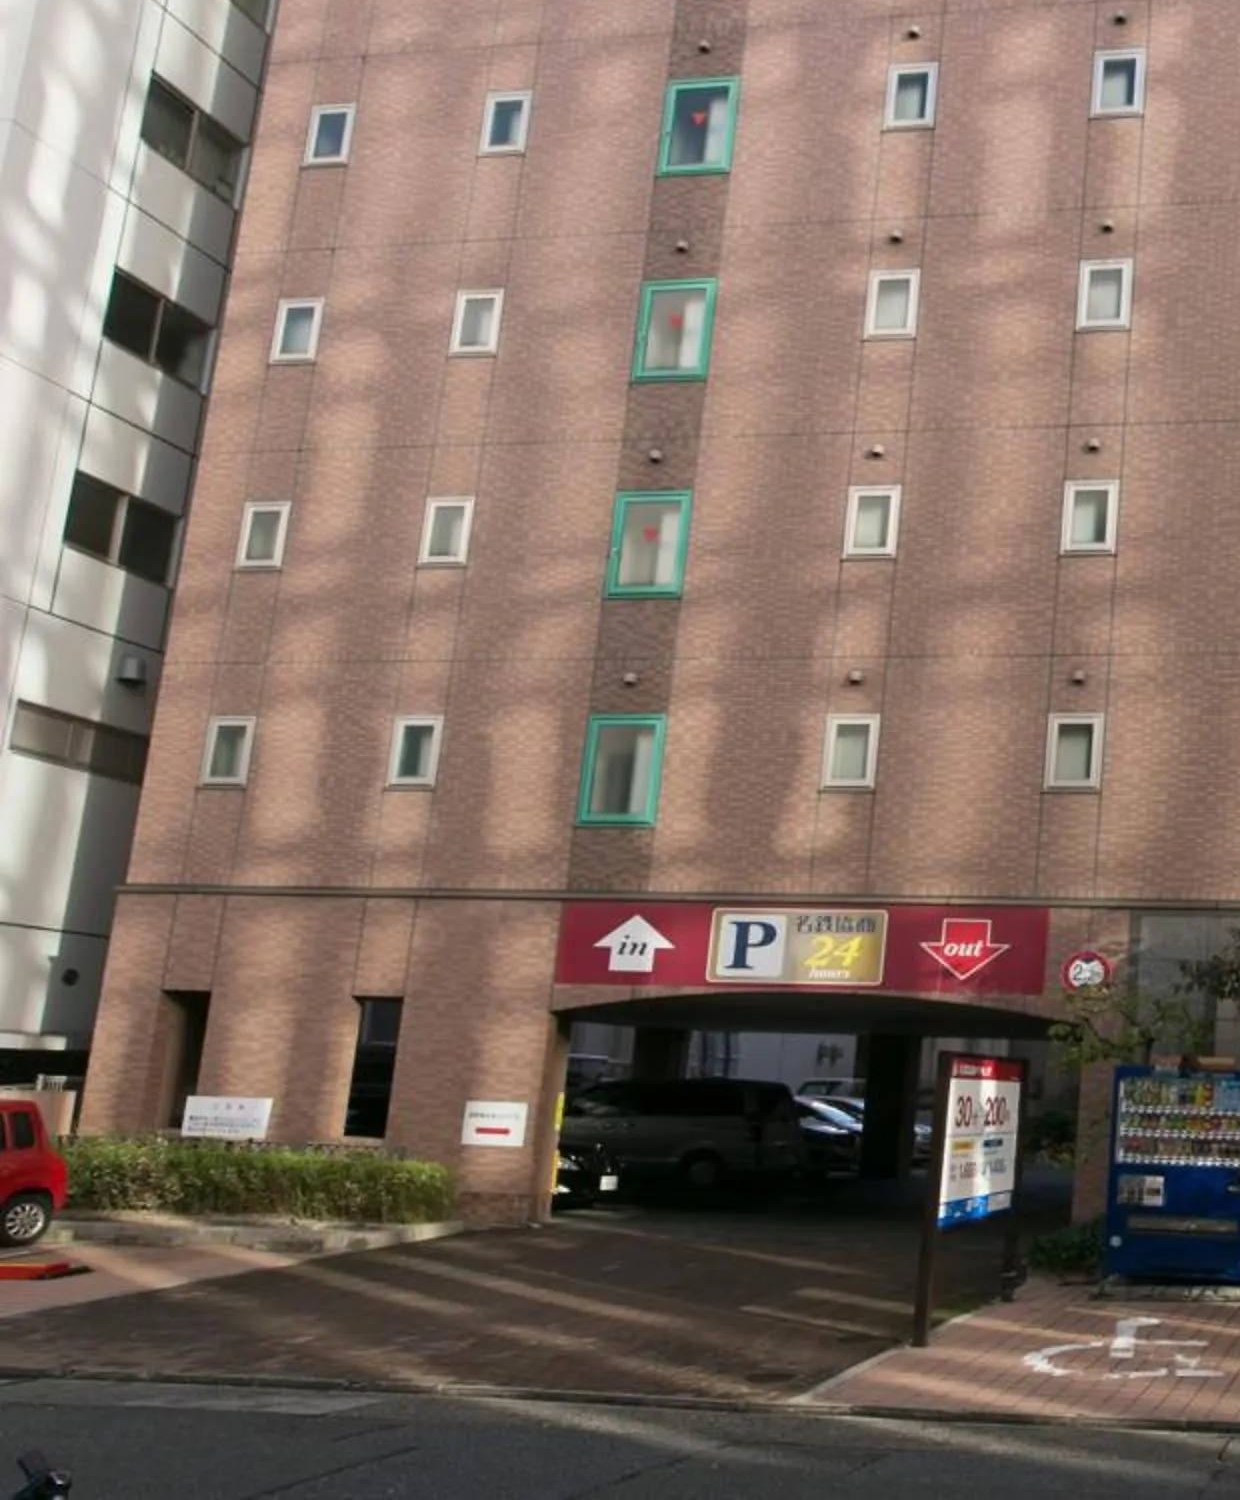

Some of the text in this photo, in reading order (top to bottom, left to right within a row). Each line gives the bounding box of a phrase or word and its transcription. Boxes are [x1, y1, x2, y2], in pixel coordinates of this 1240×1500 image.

[618, 934, 648, 956] in
[724, 920, 778, 970] P
[803, 935, 863, 967] 24
[943, 940, 984, 958] out
